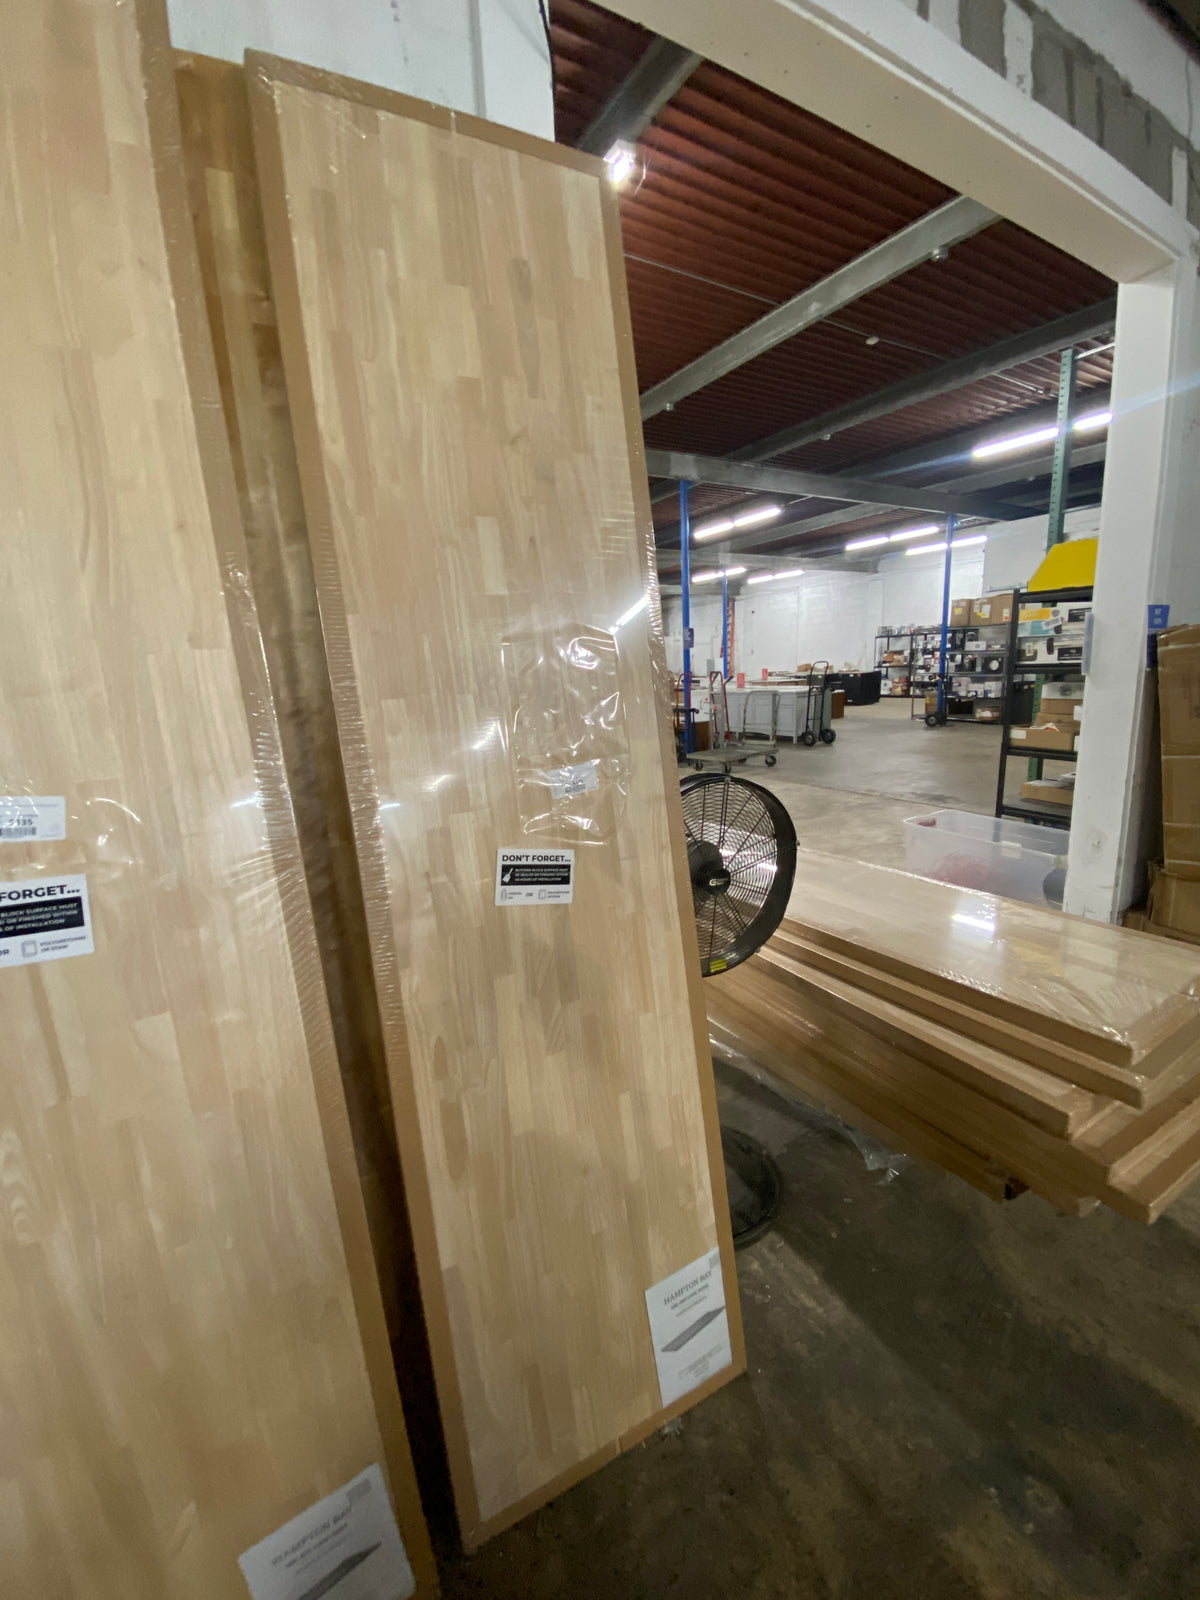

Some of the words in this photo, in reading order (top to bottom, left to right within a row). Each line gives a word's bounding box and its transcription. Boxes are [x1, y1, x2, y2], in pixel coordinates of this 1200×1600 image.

[502, 854, 530, 862] DON'T
[26, 906, 57, 914] SURFACE
[18, 913, 52, 922] FINISHED
[16, 918, 65, 930] INSTALLATION
[664, 1276, 699, 1305] HAMPTON
[700, 1271, 712, 1282] BAY
